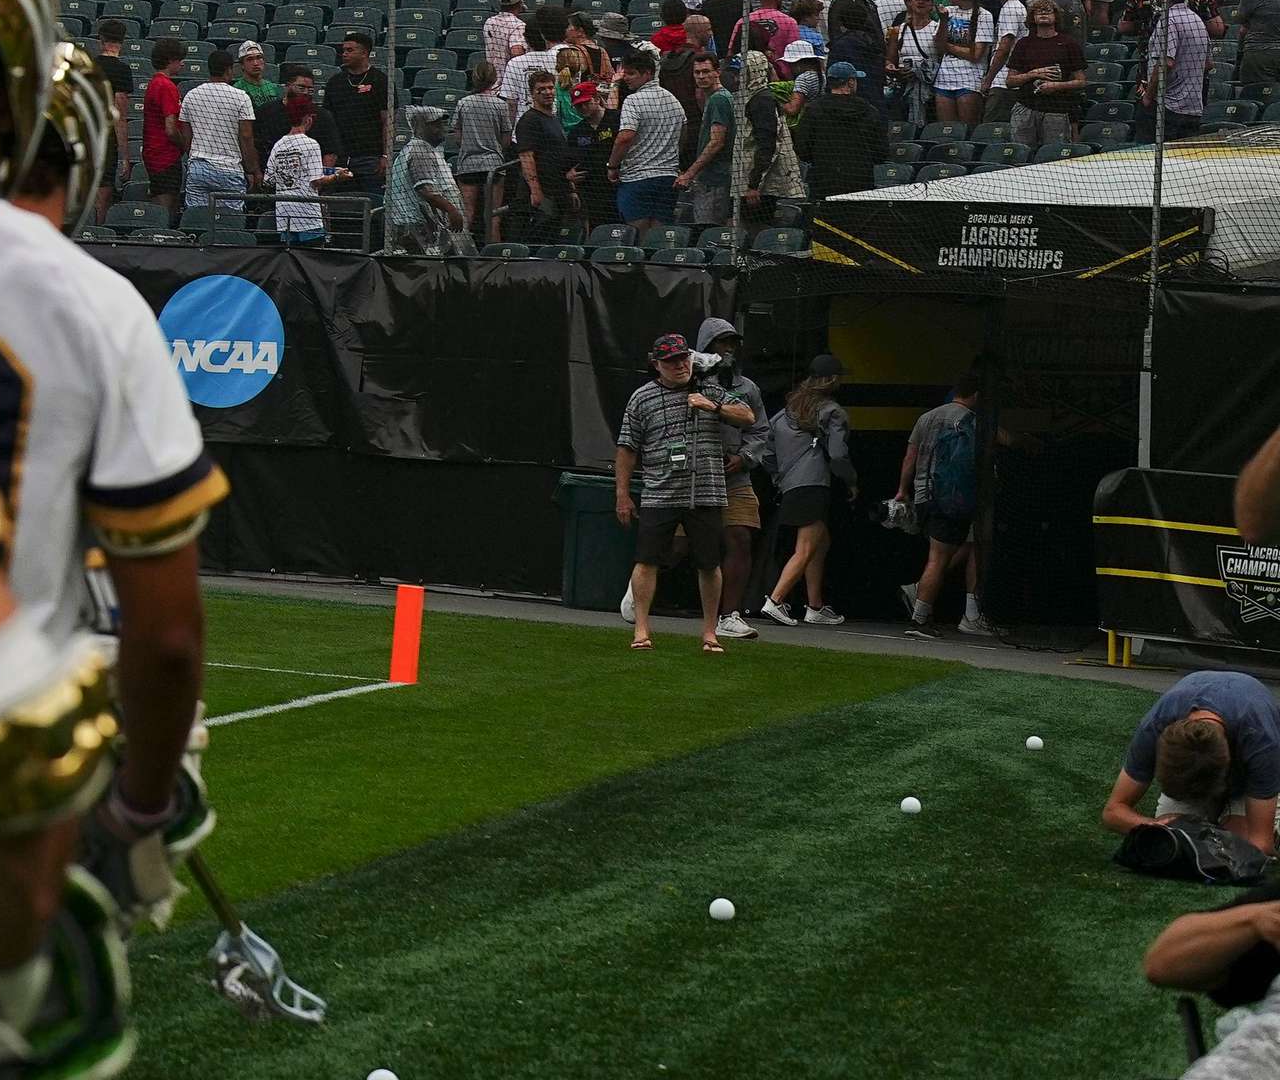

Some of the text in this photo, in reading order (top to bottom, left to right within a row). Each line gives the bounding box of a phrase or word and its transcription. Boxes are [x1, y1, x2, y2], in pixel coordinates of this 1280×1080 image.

[961, 226, 1040, 247] LACROSSE
[937, 246, 1064, 270] CHAMPIONSHIPS
[171, 339, 279, 375] NCAA
